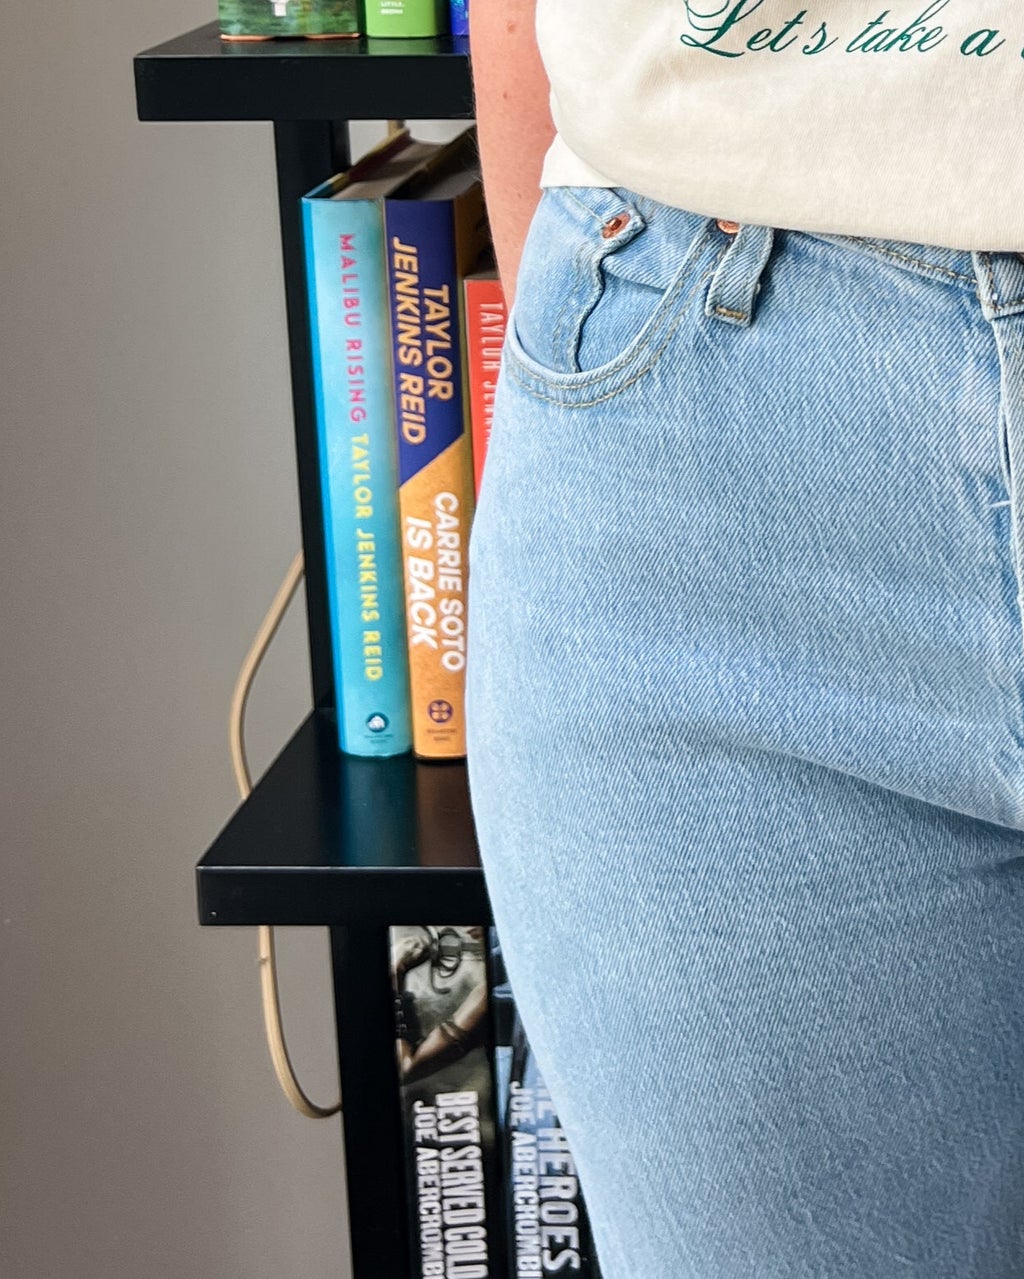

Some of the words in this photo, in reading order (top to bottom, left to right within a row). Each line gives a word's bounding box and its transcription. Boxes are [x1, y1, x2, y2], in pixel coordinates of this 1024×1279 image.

[960, 28, 1005, 57] a
[339, 234, 361, 327] MALIBU
[392, 235, 422, 368] JENKINS
[345, 339, 367, 424] RISING
[423, 284, 454, 402] TAYLOR
[400, 373, 427, 445] REID
[351, 433, 373, 519] TAYLOR
[406, 515, 434, 550] IS
[434, 491, 463, 592] CARRIE
[355, 528, 380, 623] JENKINS
[407, 558, 439, 650] BACK
[363, 630, 383, 682] REID
[439, 596, 466, 672] SOTO
[413, 1100, 439, 1143] JOE
[435, 1091, 481, 1144] BEST
[510, 1080, 536, 1127] JOE
[440, 1145, 486, 1226] SERVED
[511, 1131, 543, 1279] ABERCROMBI
[539, 1128, 581, 1271] HEROES
[444, 1226, 489, 1279] COLD
